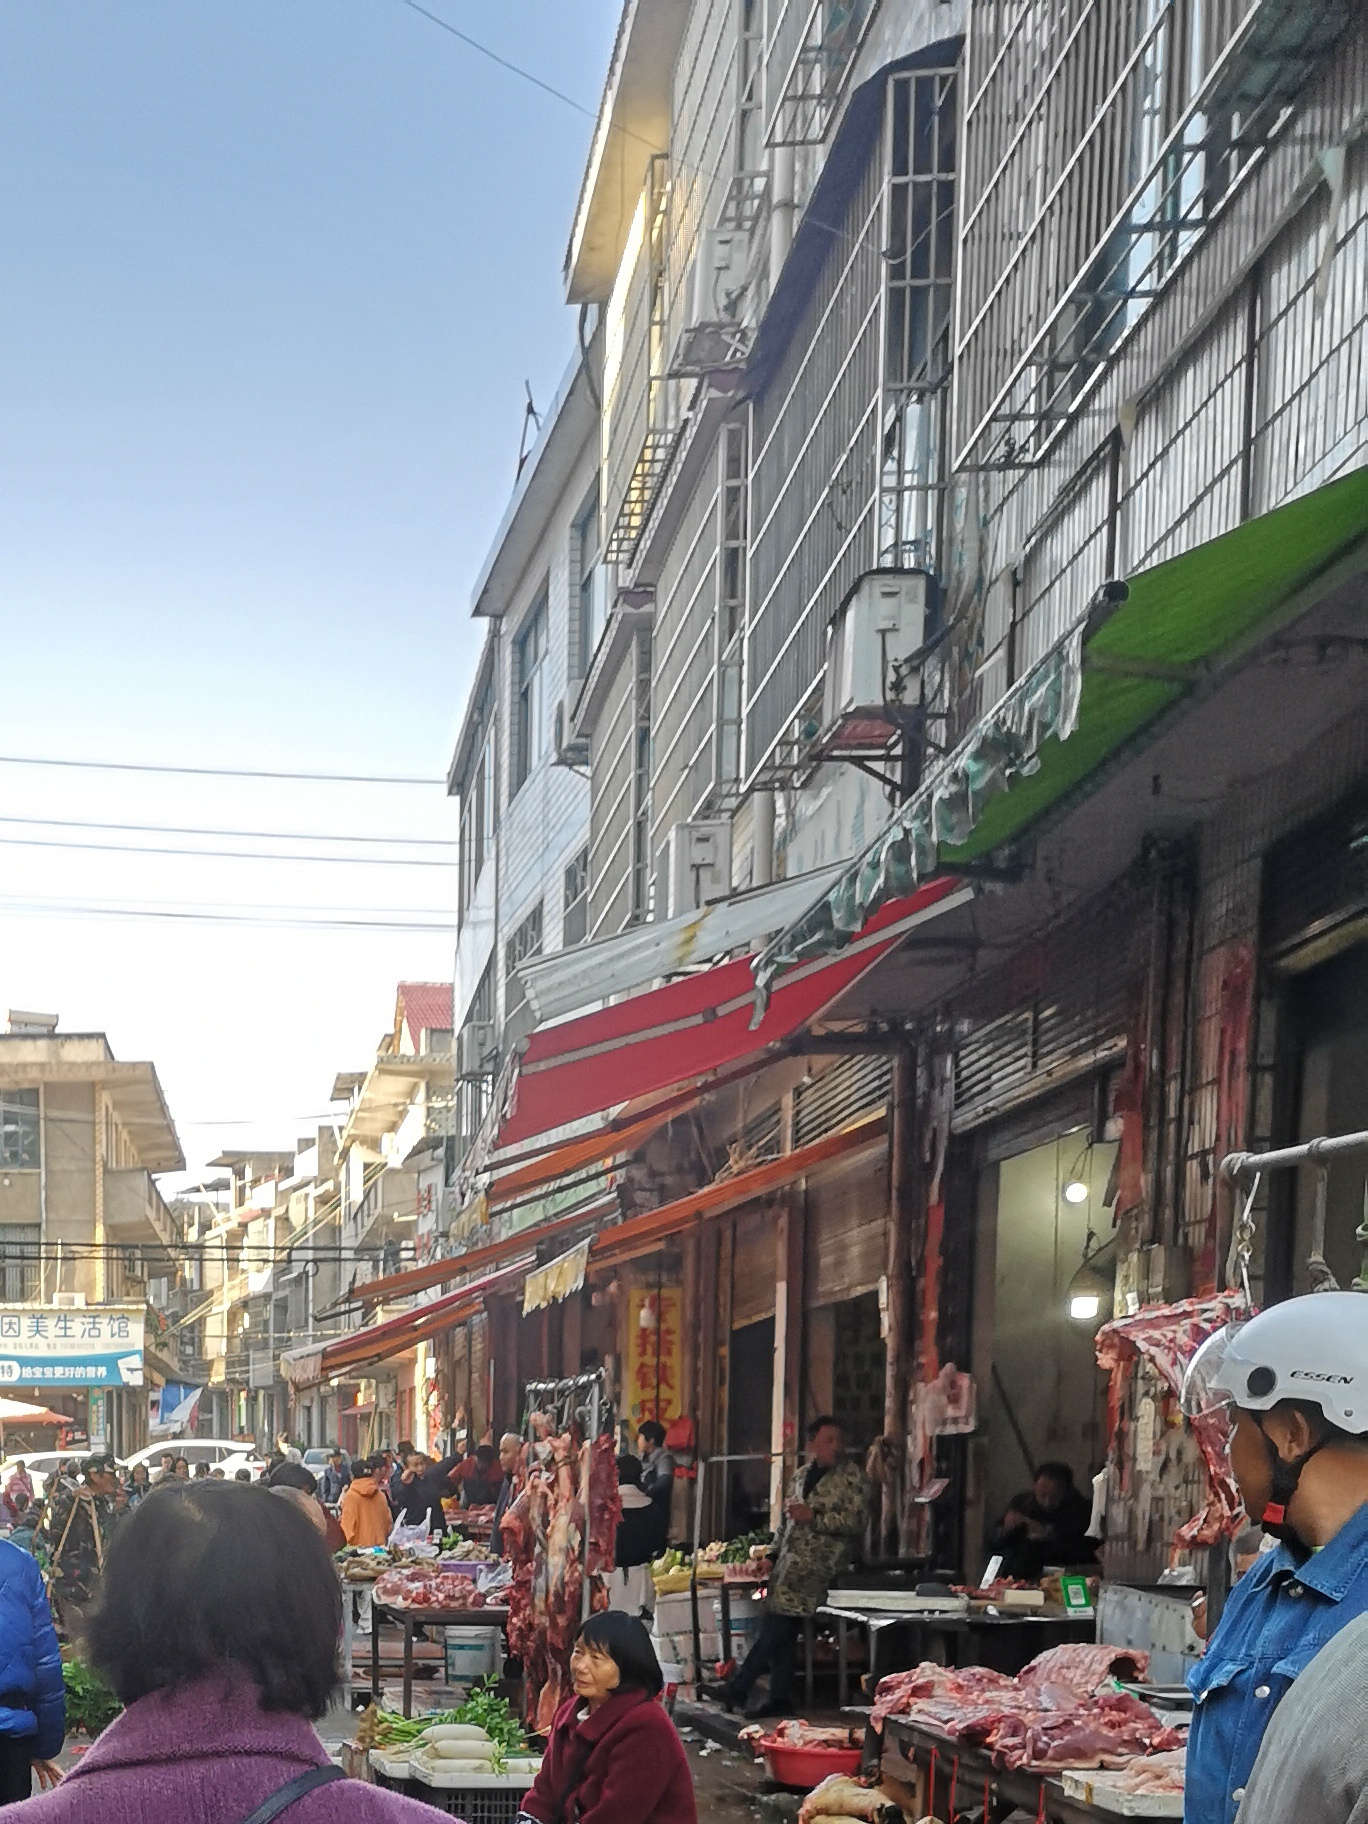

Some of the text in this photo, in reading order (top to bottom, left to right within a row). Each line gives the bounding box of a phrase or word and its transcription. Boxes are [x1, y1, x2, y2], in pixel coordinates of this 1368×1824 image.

[636, 1294, 678, 1432] 专搭铁皮
[21, 1366, 107, 1379] 给宝宝更好的营养
[1290, 1369, 1355, 1385] ESSEN
